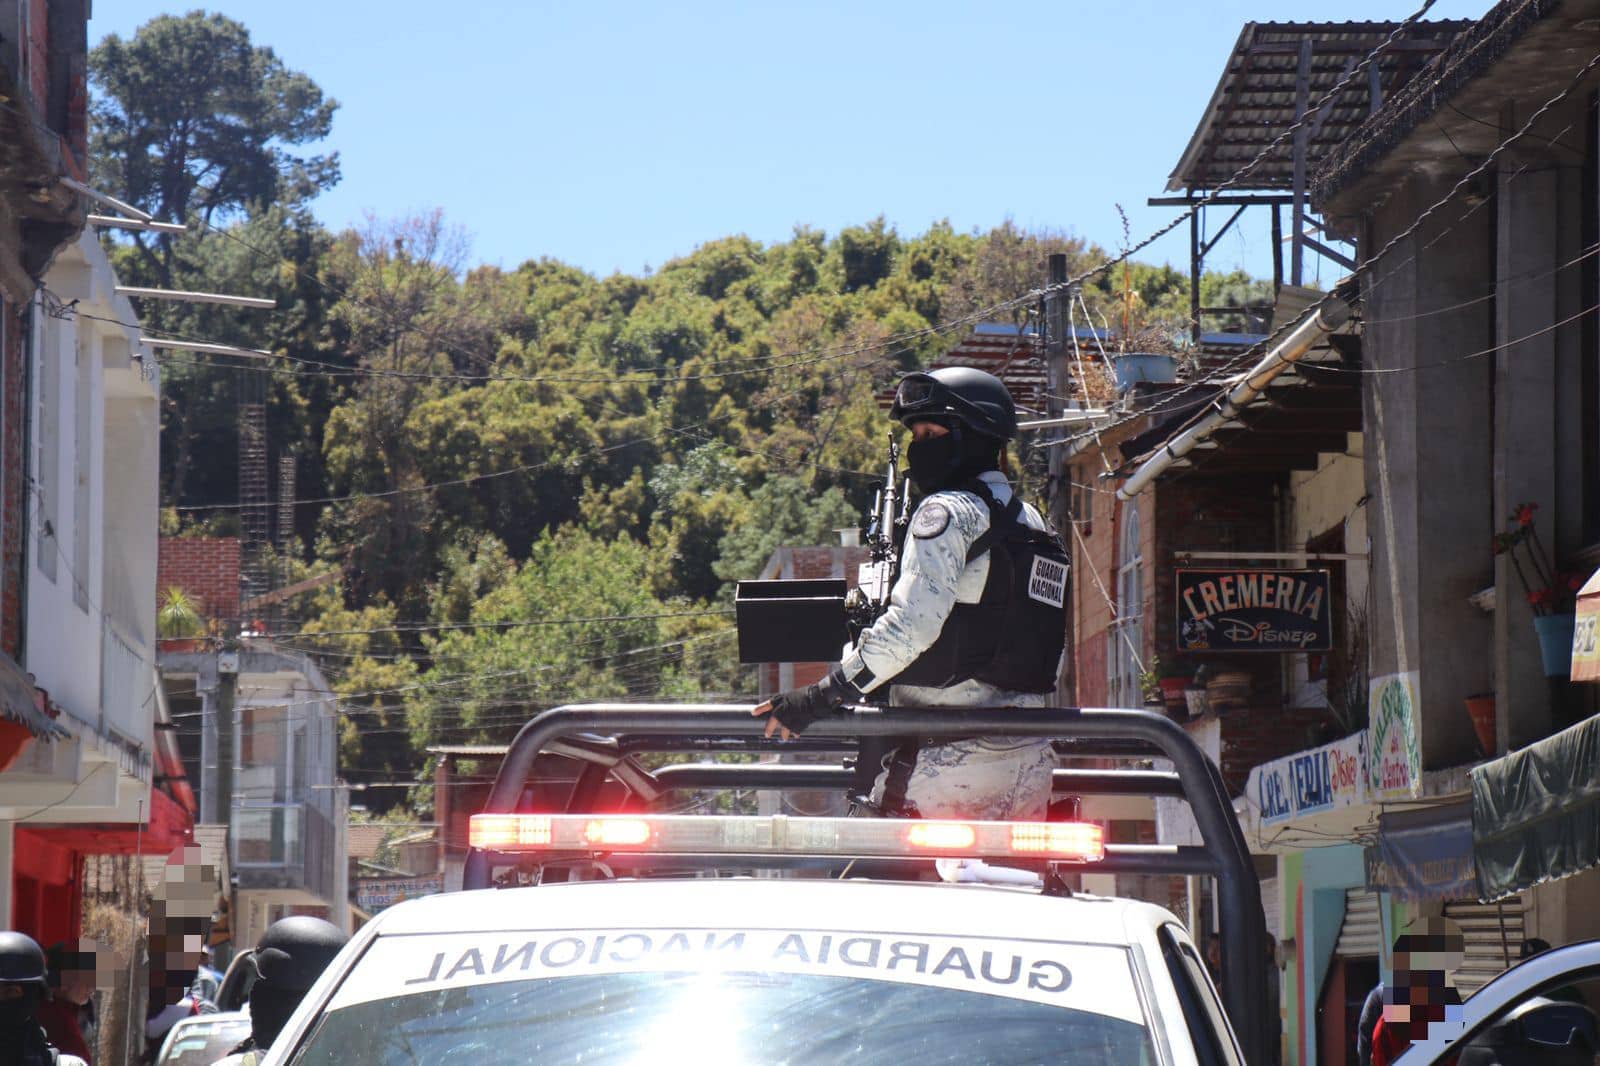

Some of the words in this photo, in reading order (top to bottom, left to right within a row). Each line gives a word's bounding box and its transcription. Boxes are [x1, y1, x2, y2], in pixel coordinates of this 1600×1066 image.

[1035, 560, 1064, 582] GUARDIA
[1031, 579, 1062, 603] NACIONAL
[1183, 574, 1323, 621] CREMERIA
